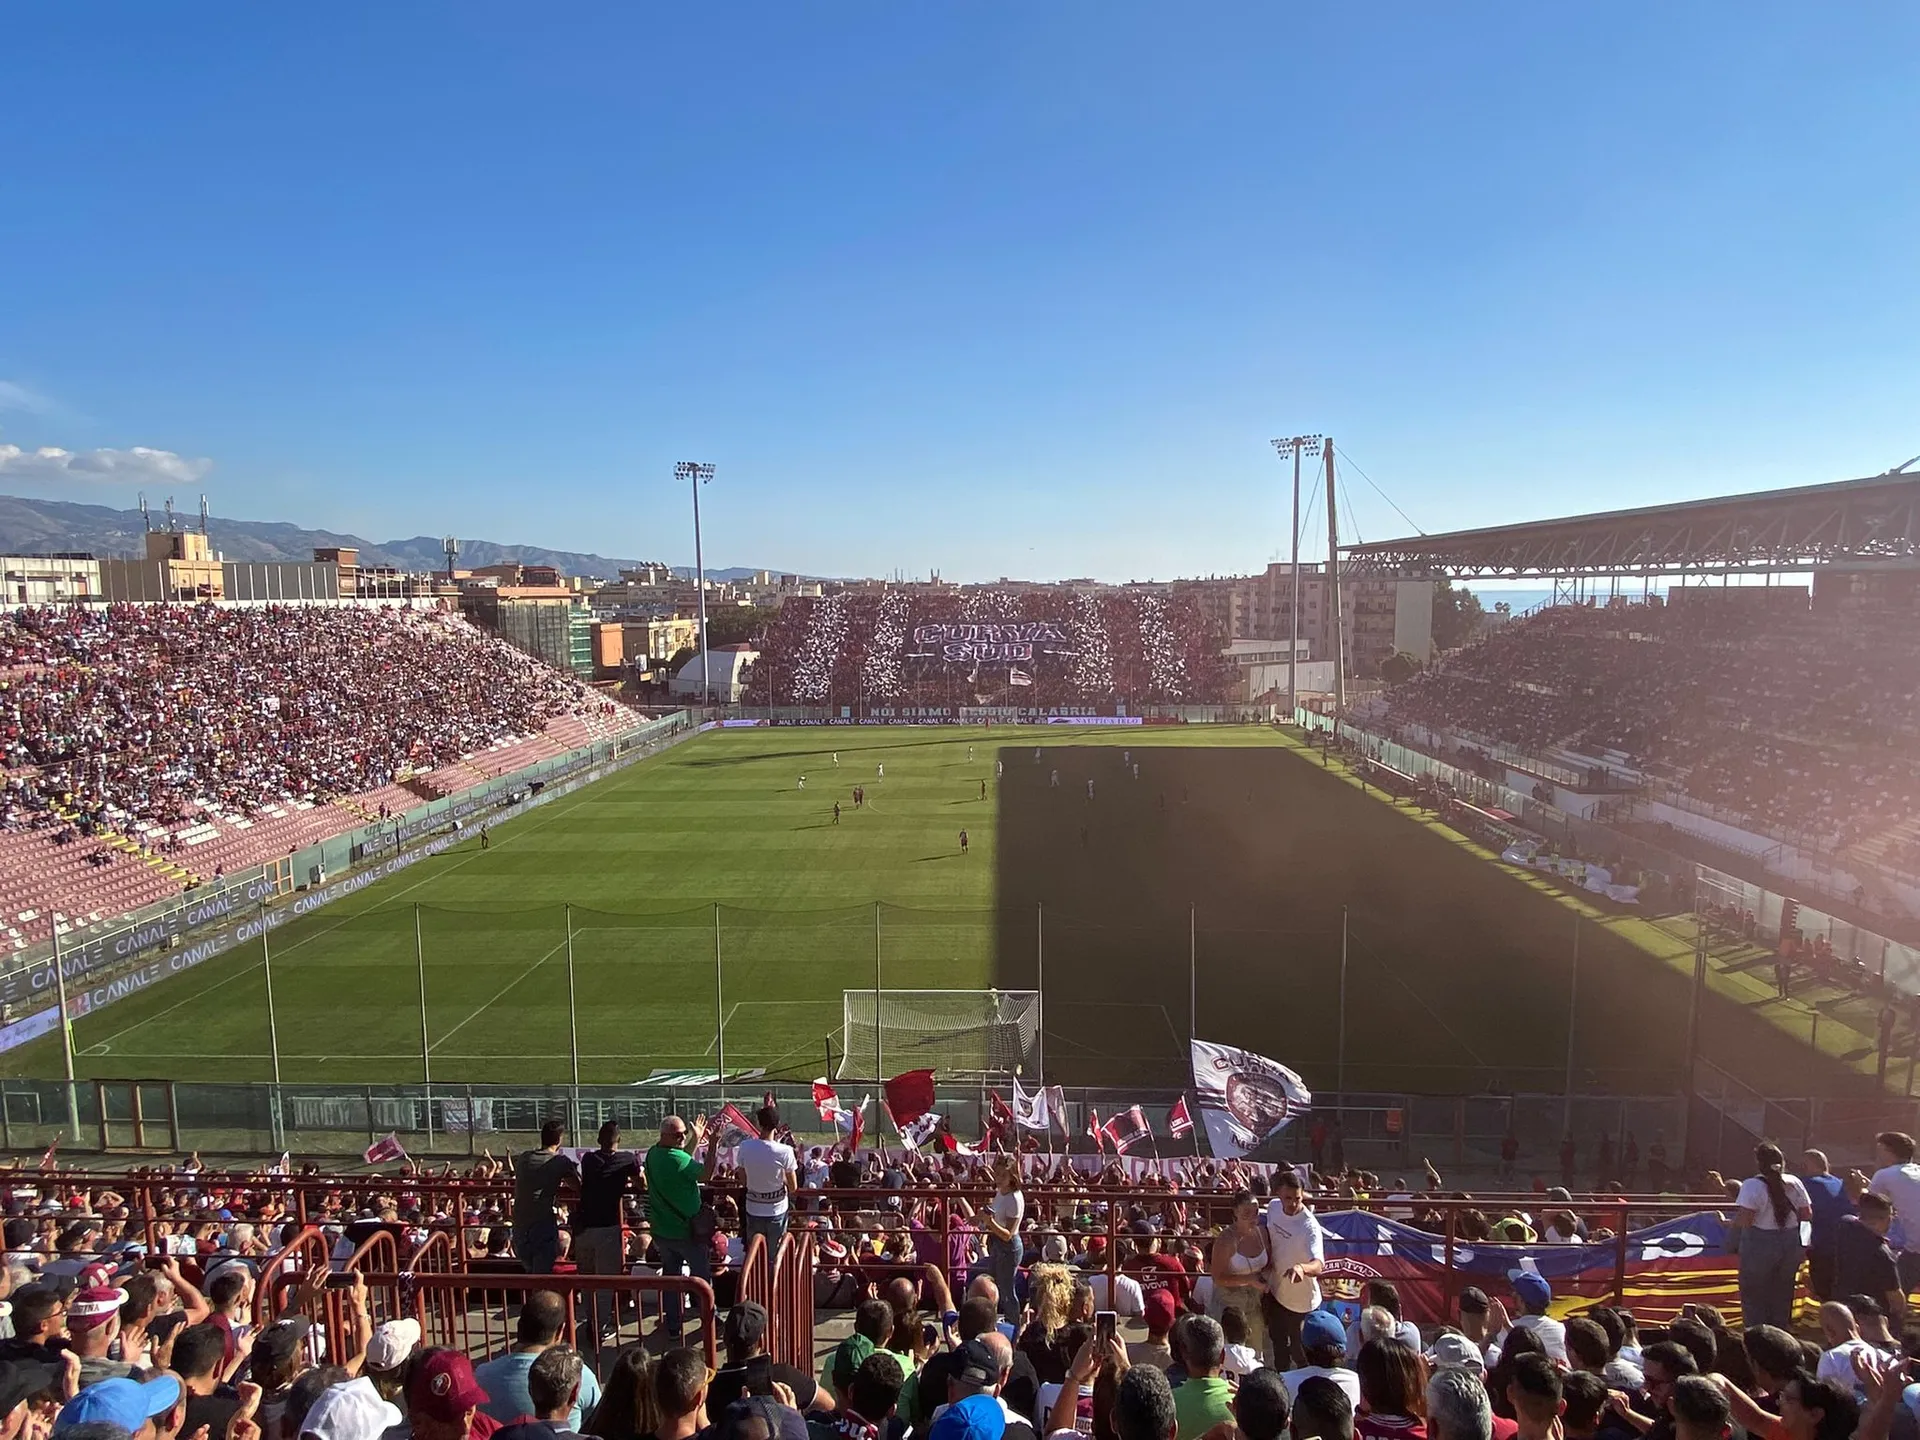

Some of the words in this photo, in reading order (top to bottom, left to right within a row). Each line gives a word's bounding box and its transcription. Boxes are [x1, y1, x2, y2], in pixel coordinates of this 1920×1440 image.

[913, 622, 1067, 645] CURVA
[942, 642, 1033, 662] SUD
[870, 707, 895, 717] NOI
[902, 707, 952, 717] SIAMO
[1018, 706, 1097, 716] CALABRIA
[115, 918, 178, 955] CANALE
[187, 892, 240, 925] CANALE
[93, 963, 162, 1005] CANALE
[171, 934, 228, 970] CANALE
[293, 885, 338, 914] CANALE
[343, 866, 382, 893] CANALE
